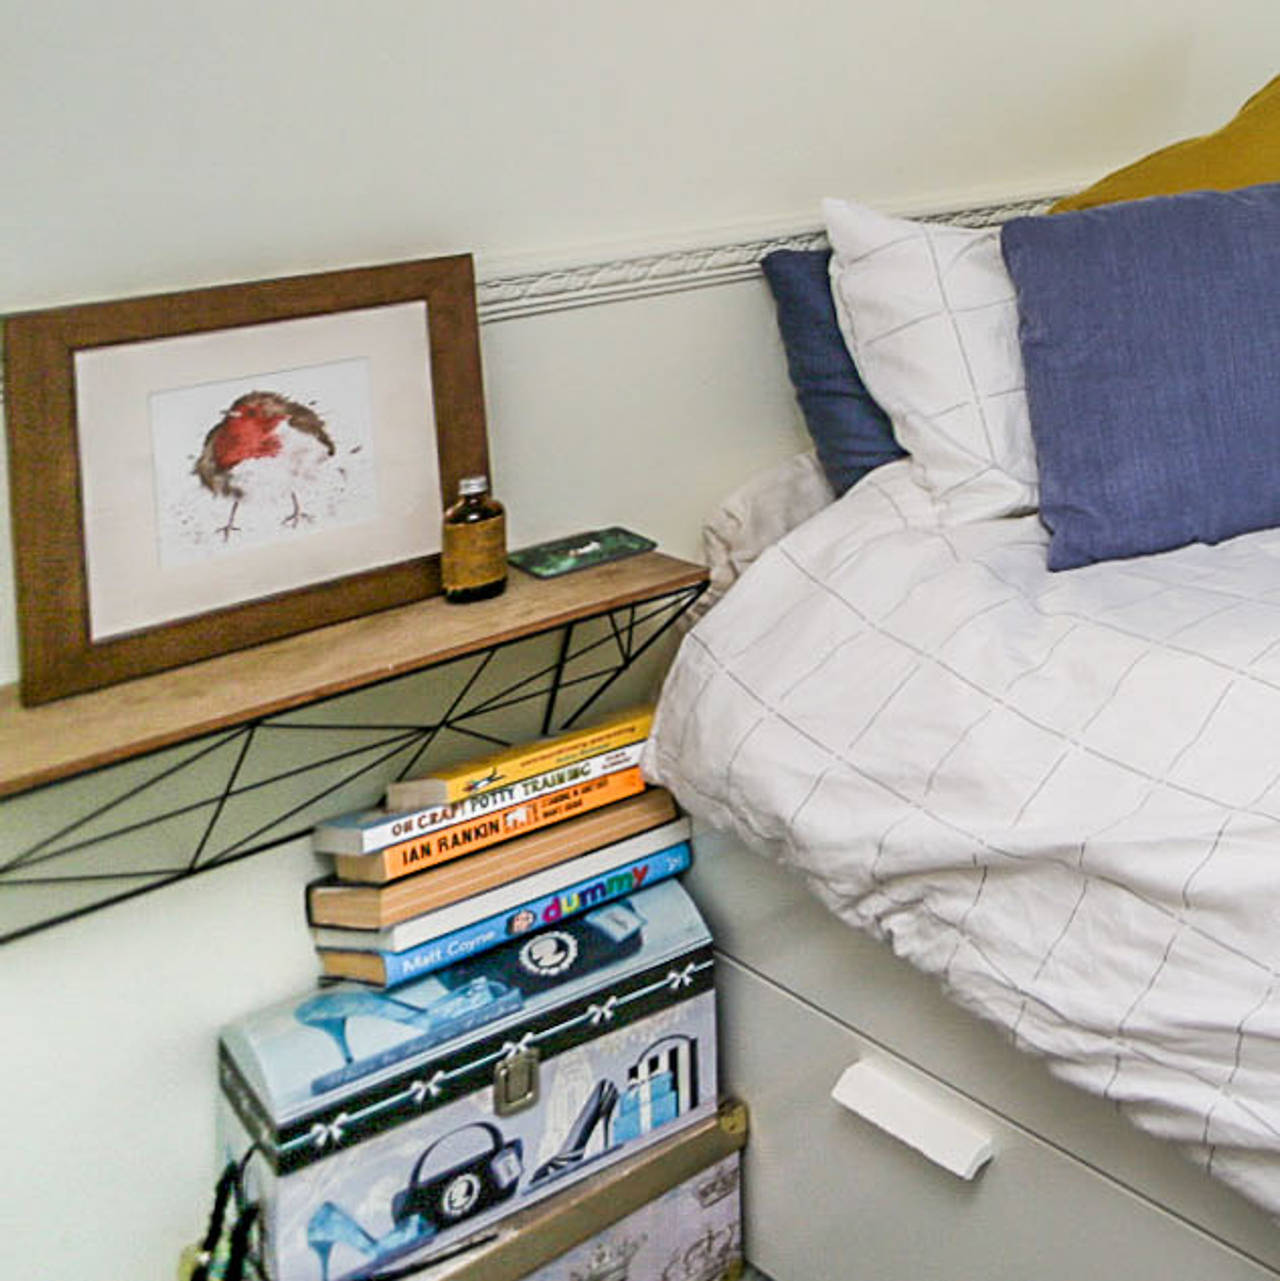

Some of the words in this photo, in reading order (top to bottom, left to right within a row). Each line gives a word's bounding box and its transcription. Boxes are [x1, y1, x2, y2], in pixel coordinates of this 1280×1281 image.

[469, 787, 515, 812] POTTY
[522, 762, 592, 797] TRAINING
[402, 841, 432, 865] IAN
[438, 819, 499, 852] RANKIN
[541, 864, 650, 924] dummy
[402, 949, 442, 972] Matt
[447, 929, 497, 957] Coyne
